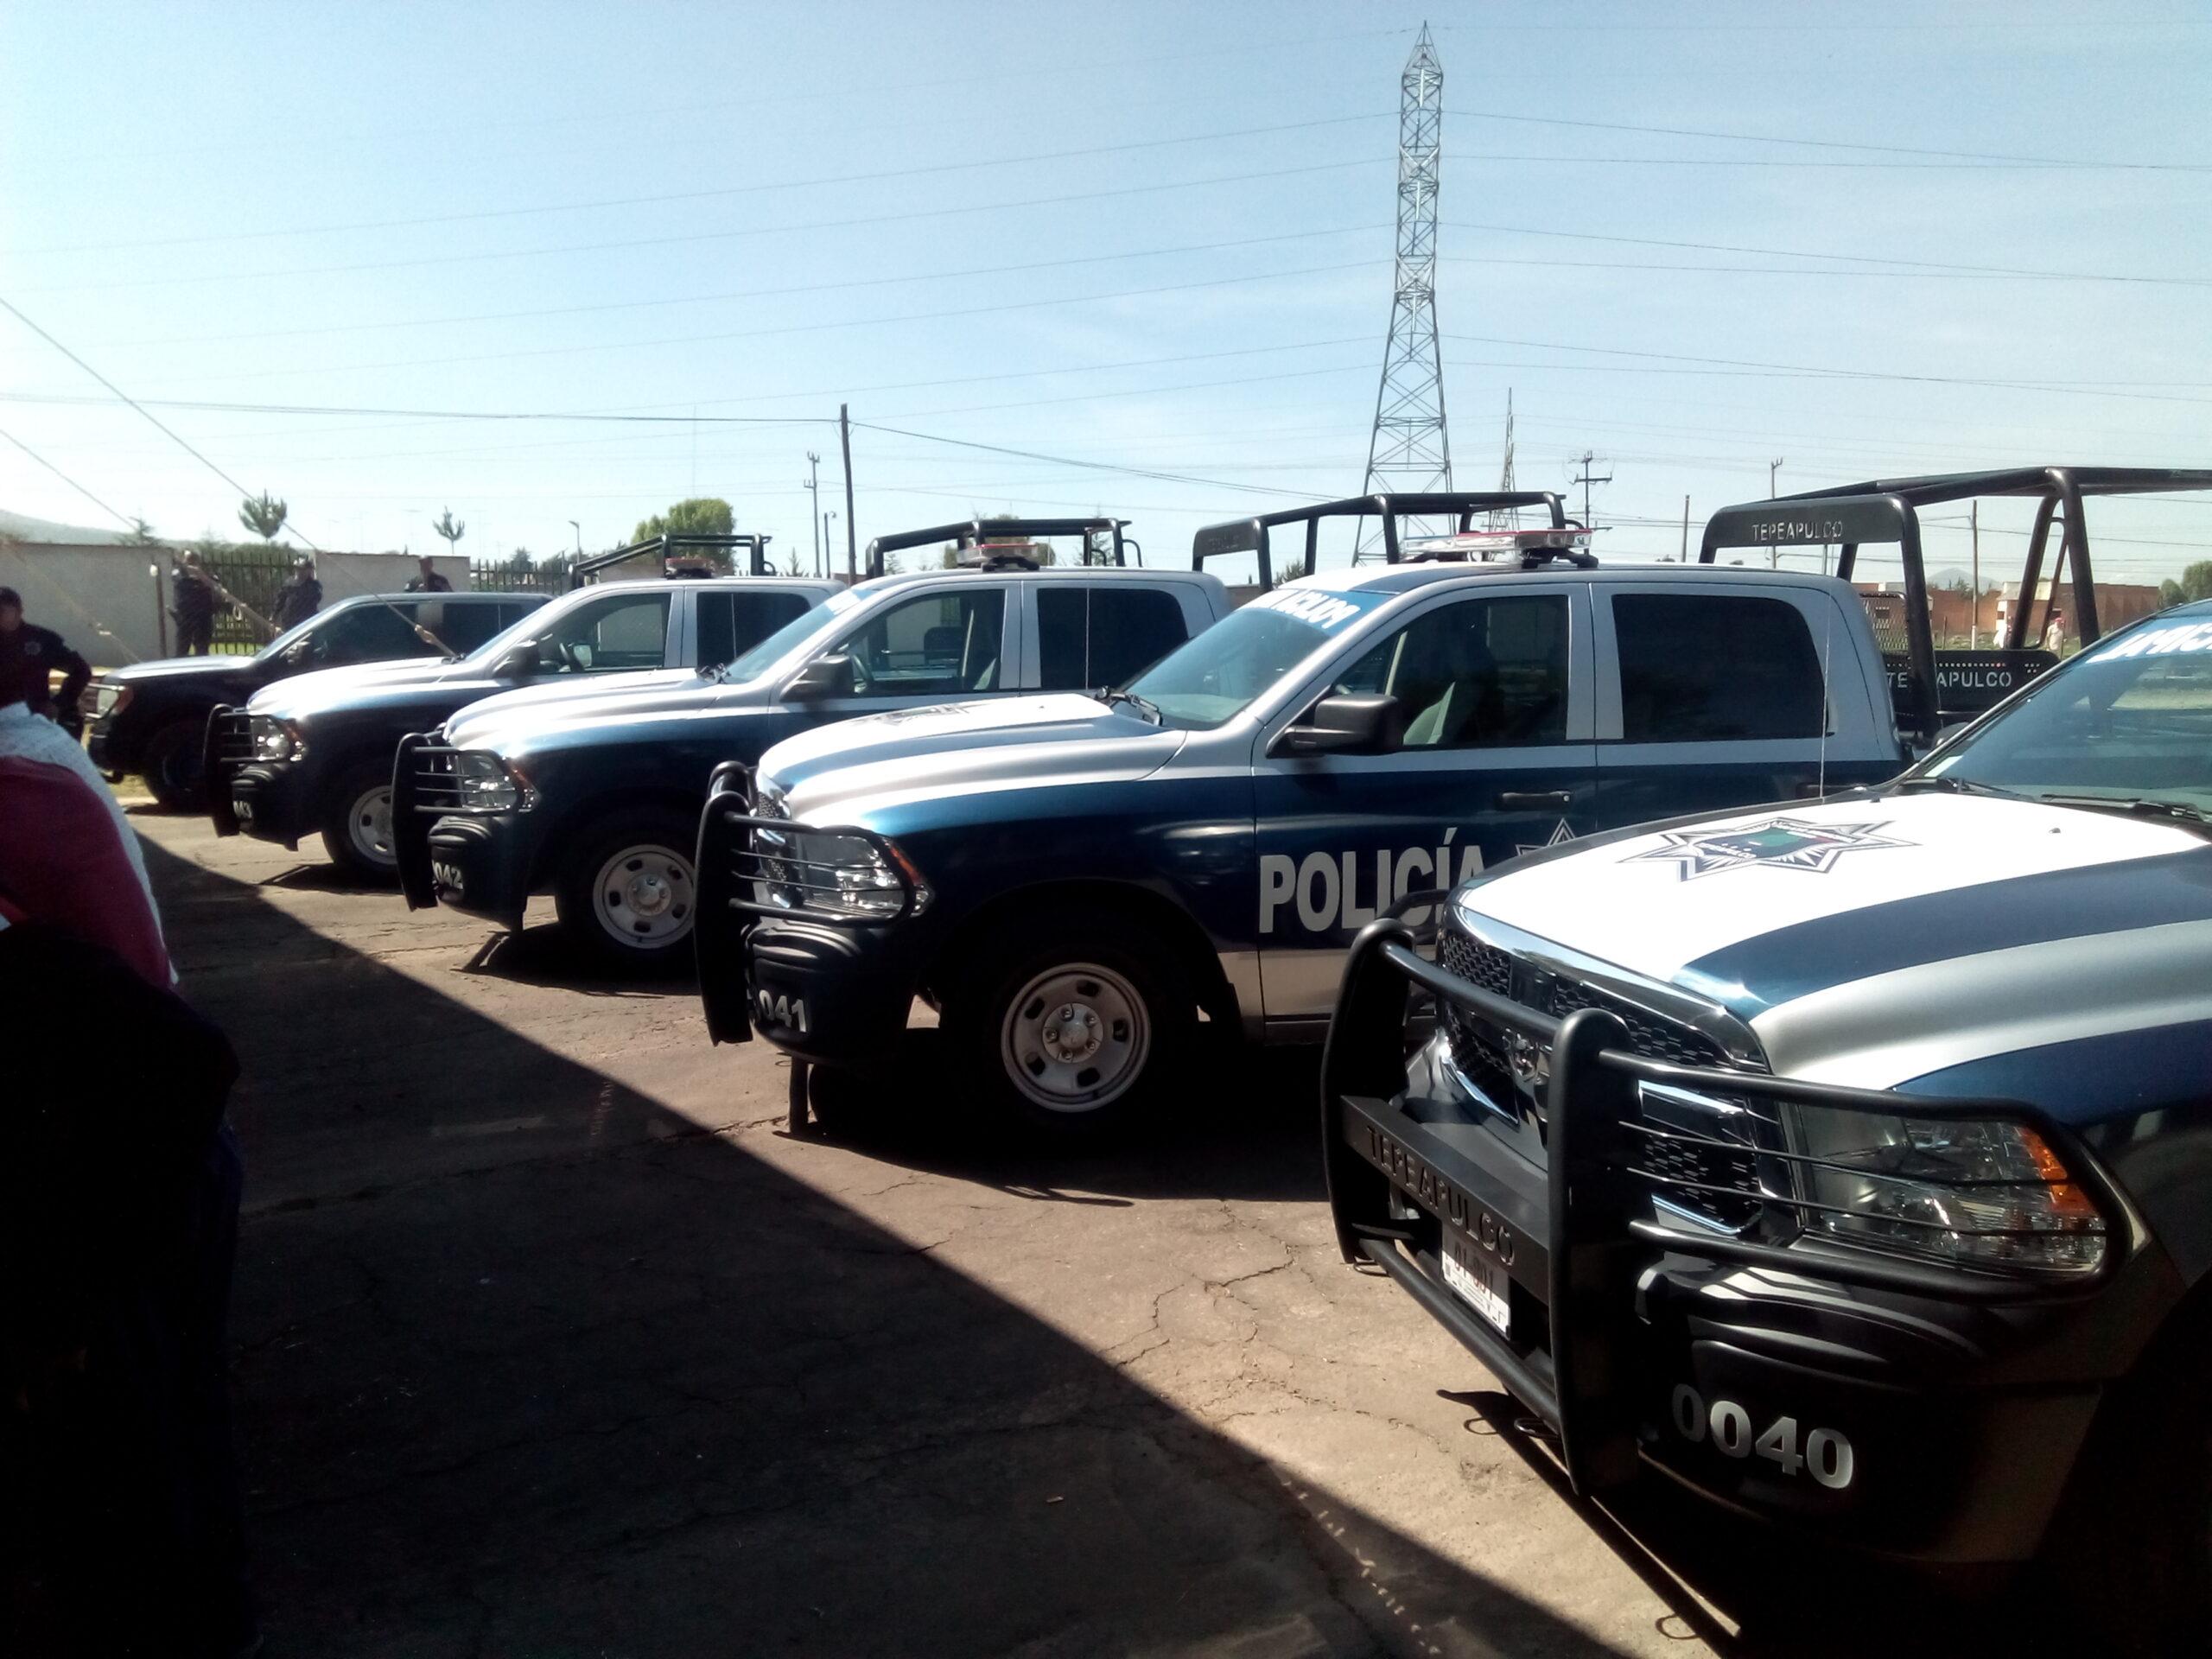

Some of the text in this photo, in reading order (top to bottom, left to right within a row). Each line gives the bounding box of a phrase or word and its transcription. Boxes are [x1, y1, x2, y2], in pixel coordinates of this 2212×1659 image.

[1752, 520, 1843, 542] TEPEAPULCO
[1886, 671, 2012, 689] TEAPULCO
[432, 859, 463, 890] 042
[759, 989, 807, 1033] 041
[1367, 1125, 1515, 1266] TEPEAPULCO
[1671, 1383, 1853, 1489] 0040
